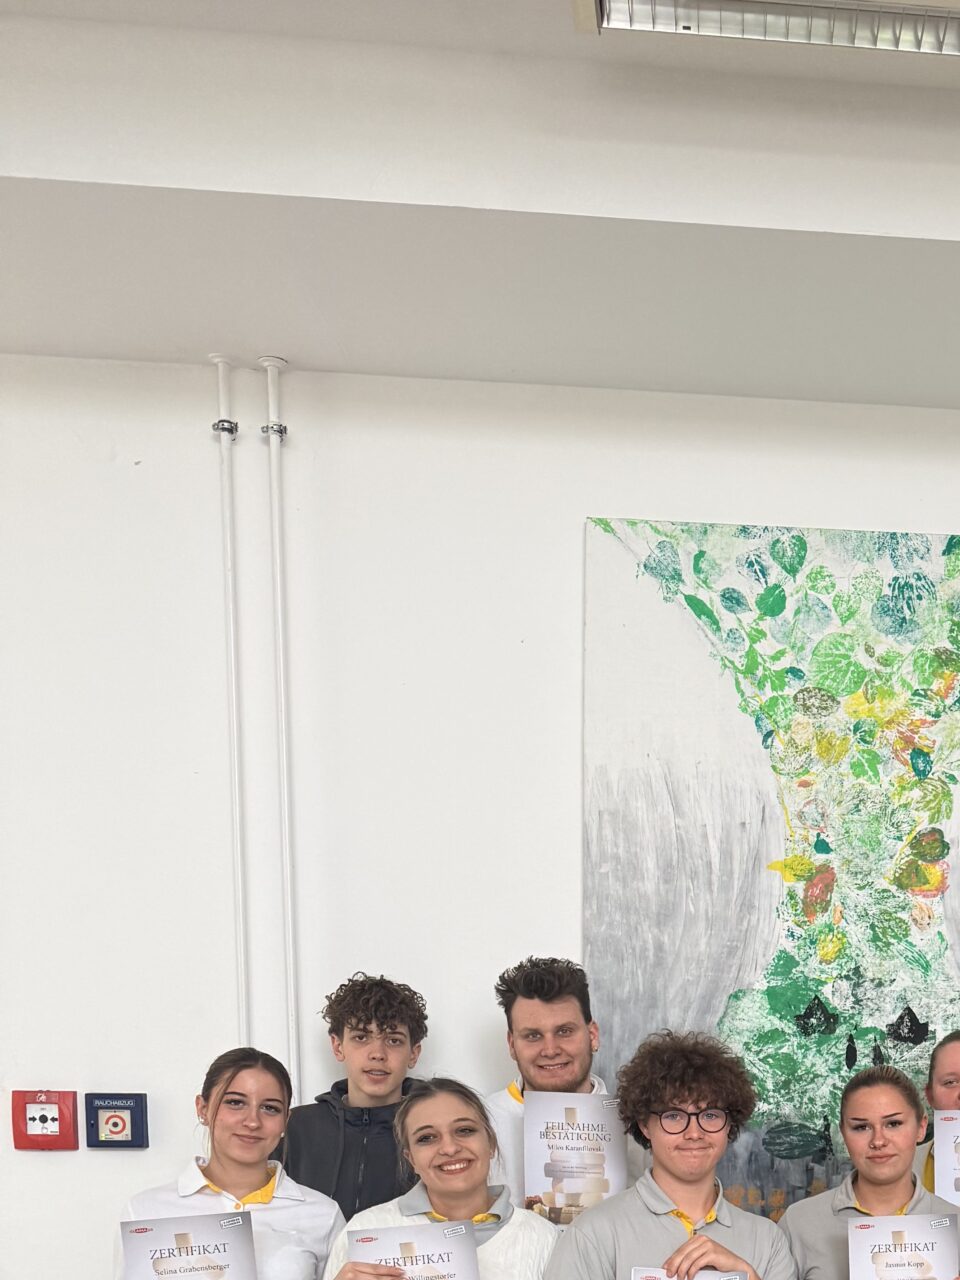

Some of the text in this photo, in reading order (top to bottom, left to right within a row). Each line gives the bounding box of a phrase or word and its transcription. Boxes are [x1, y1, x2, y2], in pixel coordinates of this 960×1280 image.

[544, 1121, 607, 1132] TEILNAHME
[540, 1131, 612, 1142] BESTÄTIGUNG
[149, 1242, 229, 1260] ZERTIFIKAT
[870, 1242, 937, 1254] ZERTIFIKAT
[155, 1263, 230, 1276] Selina Grabensberger
[908, 1261, 925, 1269] Kopp
